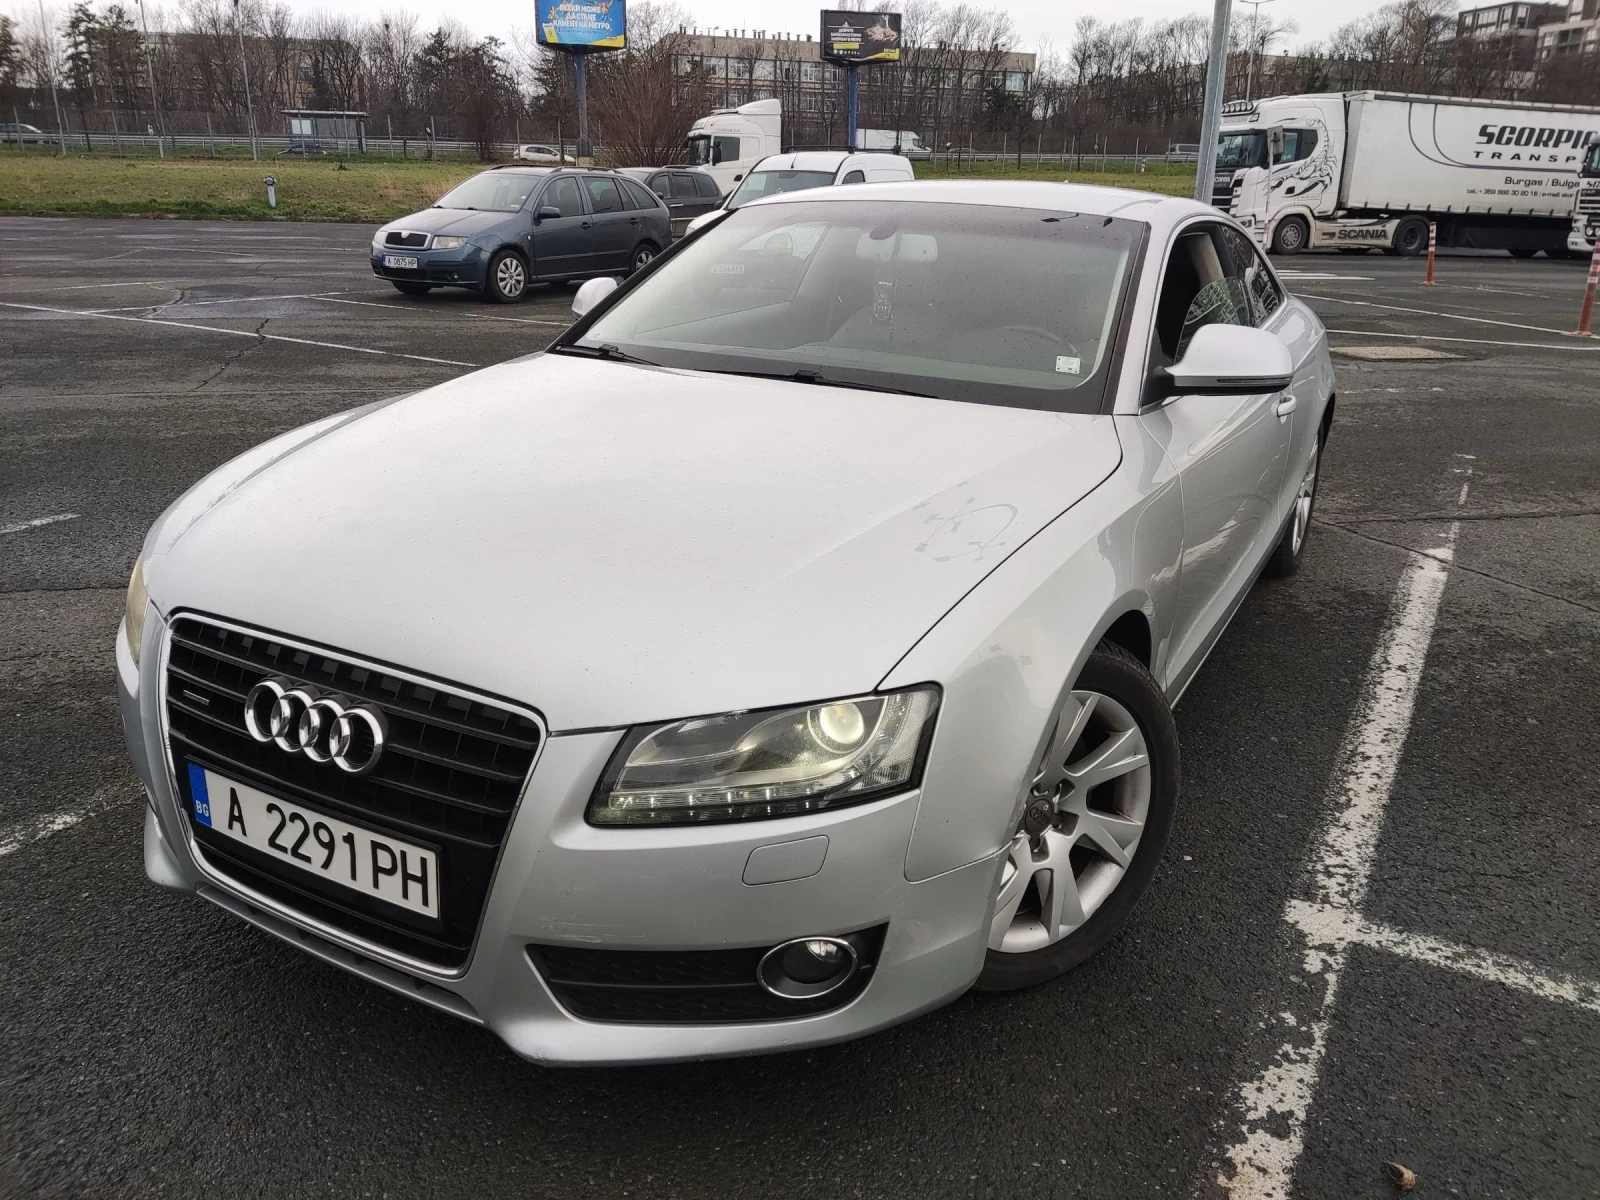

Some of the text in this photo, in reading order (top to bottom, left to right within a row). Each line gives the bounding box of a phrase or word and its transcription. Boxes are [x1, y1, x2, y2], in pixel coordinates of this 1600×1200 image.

[1504, 176, 1543, 187] Burgas
[1545, 178, 1550, 186] /
[1337, 229, 1388, 239] SCANIA
[195, 800, 210, 817] BG
[228, 787, 248, 836] A
